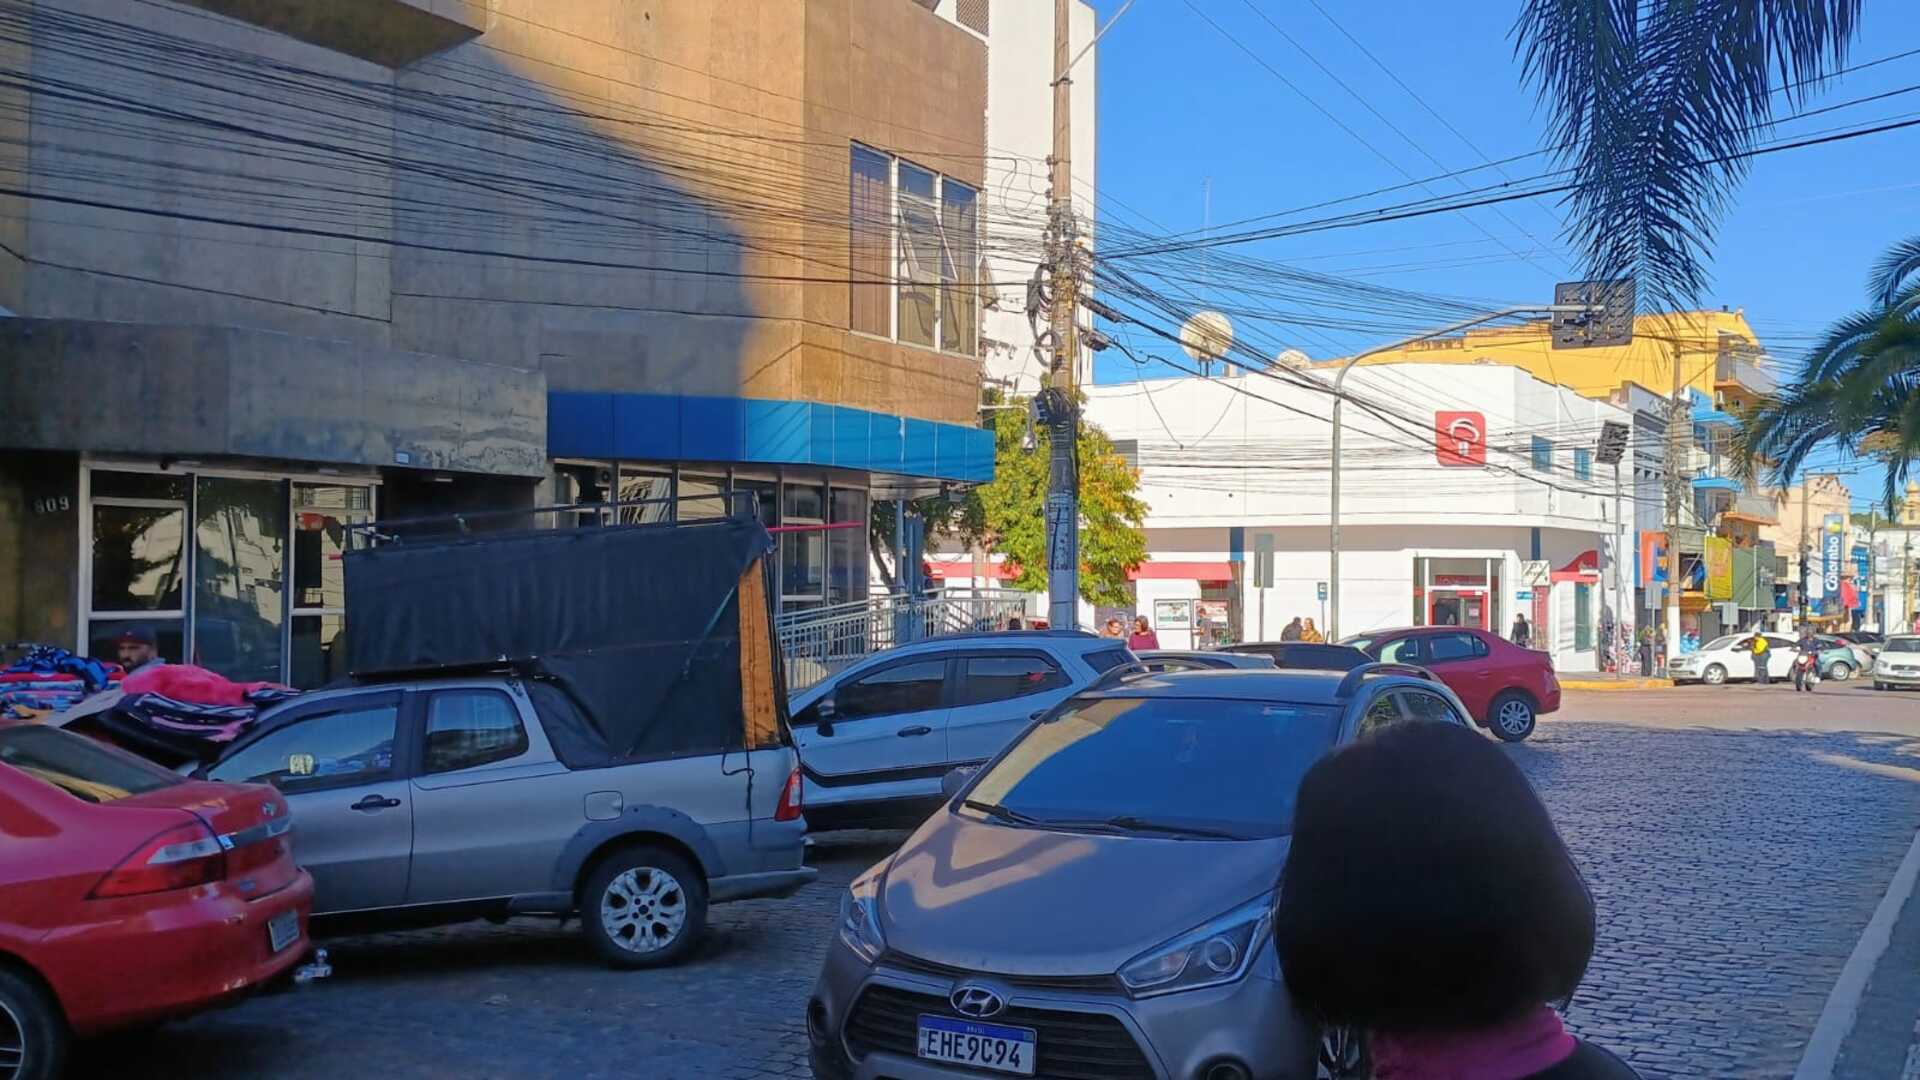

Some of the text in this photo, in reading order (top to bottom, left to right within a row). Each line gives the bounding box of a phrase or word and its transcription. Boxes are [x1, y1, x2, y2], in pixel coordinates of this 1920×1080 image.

[34, 496, 70, 514] 809
[1825, 536, 1840, 591] Colombo
[927, 1030, 1021, 1068] EHE9C94
